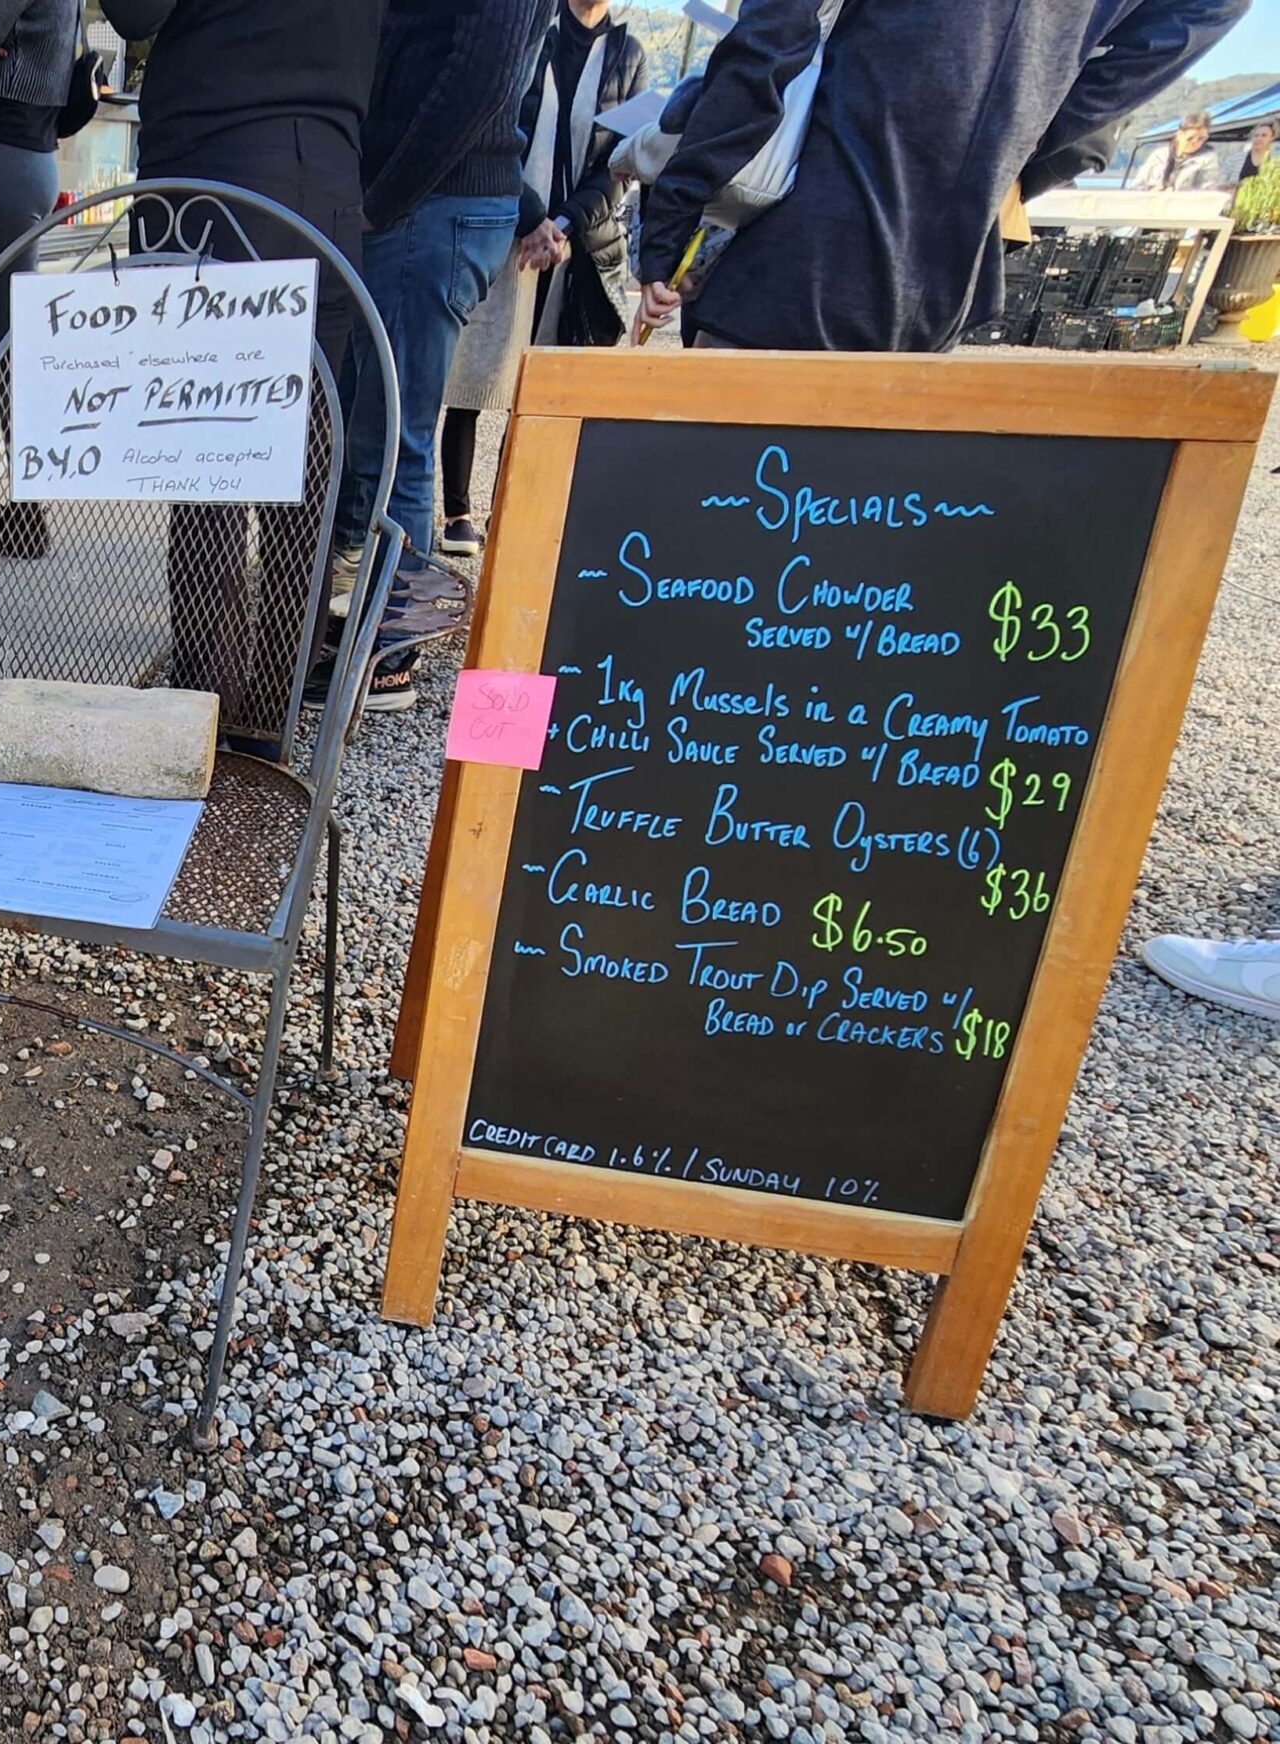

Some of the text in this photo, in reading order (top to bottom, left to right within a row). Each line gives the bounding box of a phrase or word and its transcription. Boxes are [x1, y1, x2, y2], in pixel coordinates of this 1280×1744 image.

[45, 289, 137, 336] FOOD
[177, 282, 309, 330] DRINKS
[40, 350, 265, 371] Purchased elsewhere are
[64, 373, 304, 415] NOT PERMITTED
[122, 448, 183, 464] Alcohol
[196, 445, 273, 466] accepted
[126, 475, 242, 493] THANK YOU
[619, 531, 913, 614] SEAFOOD CHOWDER
[745, 617, 831, 649] SERVED
[877, 624, 960, 656] BREAD
[989, 581, 1089, 662] $33
[373, 671, 410, 688] HOKA
[806, 686, 835, 722] in
[848, 705, 868, 724] a
[1002, 696, 1088, 746] TOMATO
[566, 714, 650, 753] CHILLI
[667, 716, 739, 764] SAUCE
[758, 725, 846, 767] SERVED
[897, 750, 981, 788] BREAD
[985, 758, 1071, 829] $29
[568, 766, 683, 835] TRUFFLE
[705, 784, 810, 848] BUTTER
[981, 863, 1049, 919] $36
[548, 849, 926, 956] GARLIC BREAD $6.50
[560, 923, 668, 983] SMOKED
[676, 942, 763, 989] TROUT
[842, 967, 927, 1011] SERVED
[705, 998, 1011, 1060] BREAD or CRACKERS $18
[470, 1119, 541, 1148] CREDIT
[544, 1136, 595, 1161] CARD
[701, 1158, 800, 1193] SUNDAY
